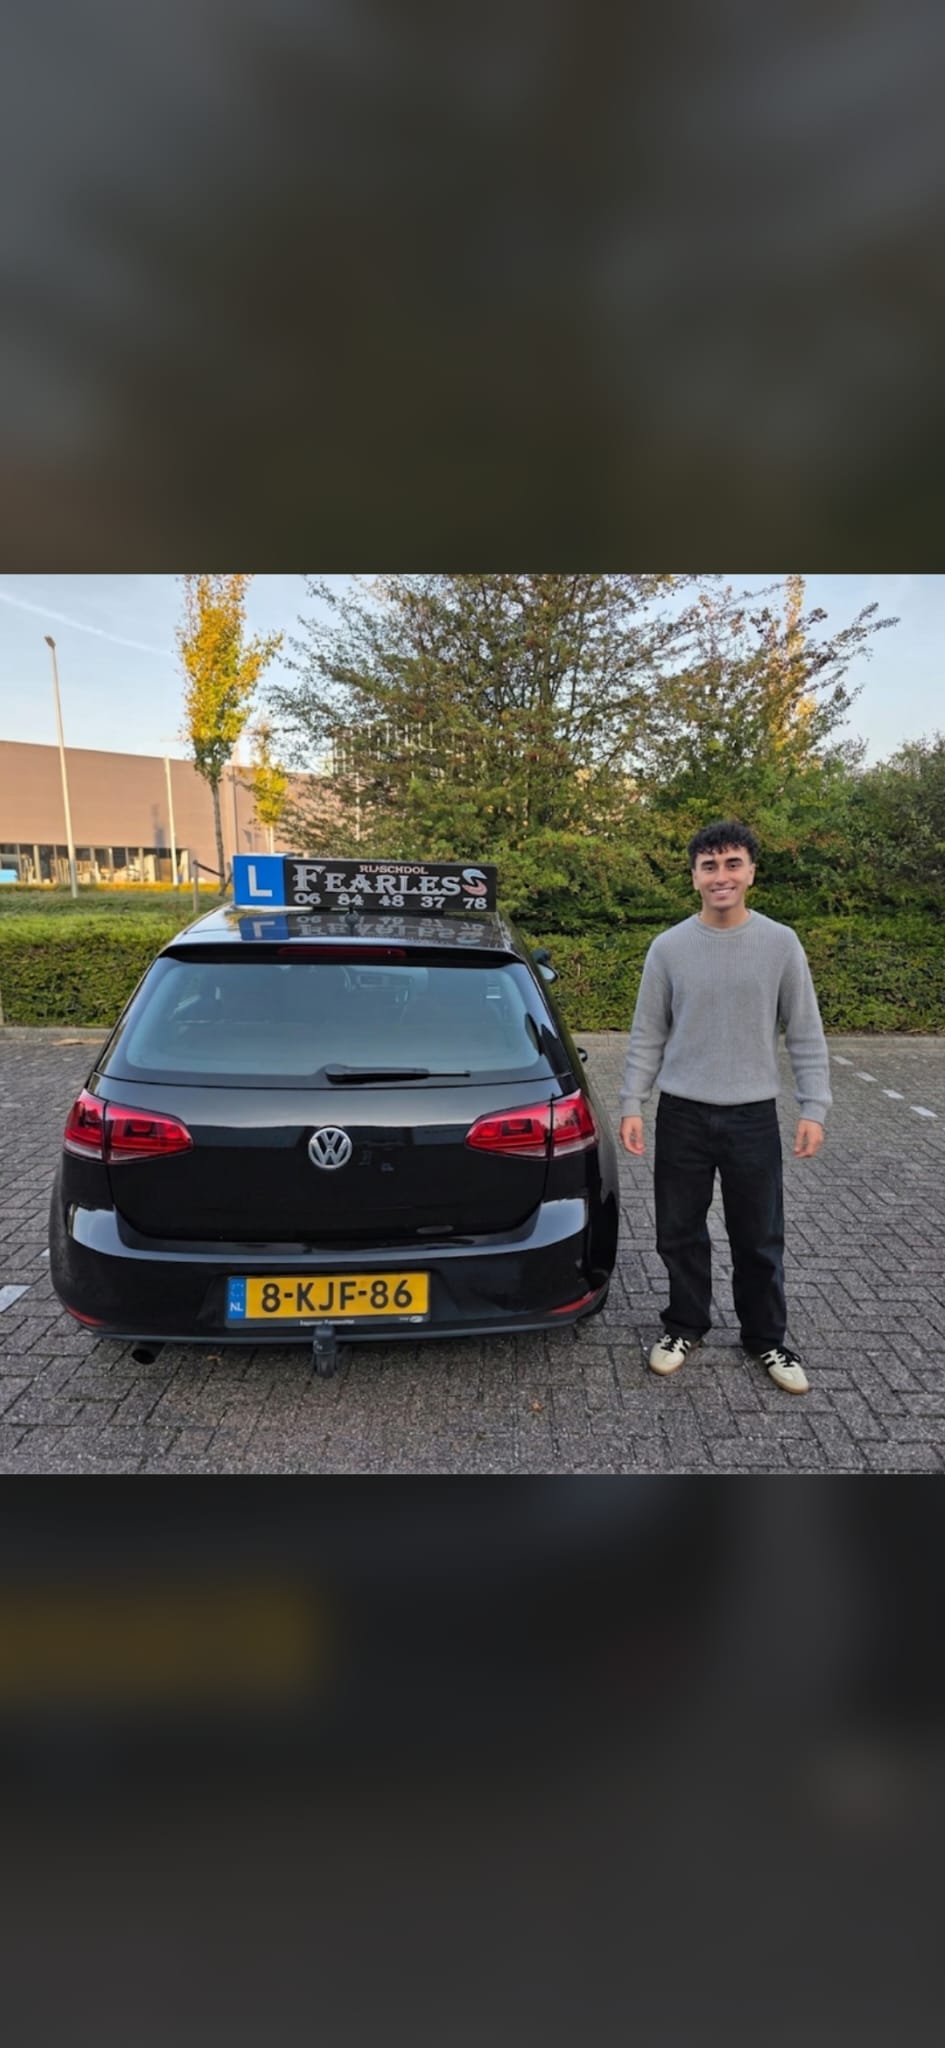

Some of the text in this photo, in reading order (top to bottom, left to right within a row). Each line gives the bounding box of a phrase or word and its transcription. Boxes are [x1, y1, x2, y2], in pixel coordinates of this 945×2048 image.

[247, 865, 273, 897] L
[294, 893, 488, 910] 06 84 48 37 78
[230, 1303, 244, 1312] NL
[261, 1279, 413, 1313] 8-KJF-86
